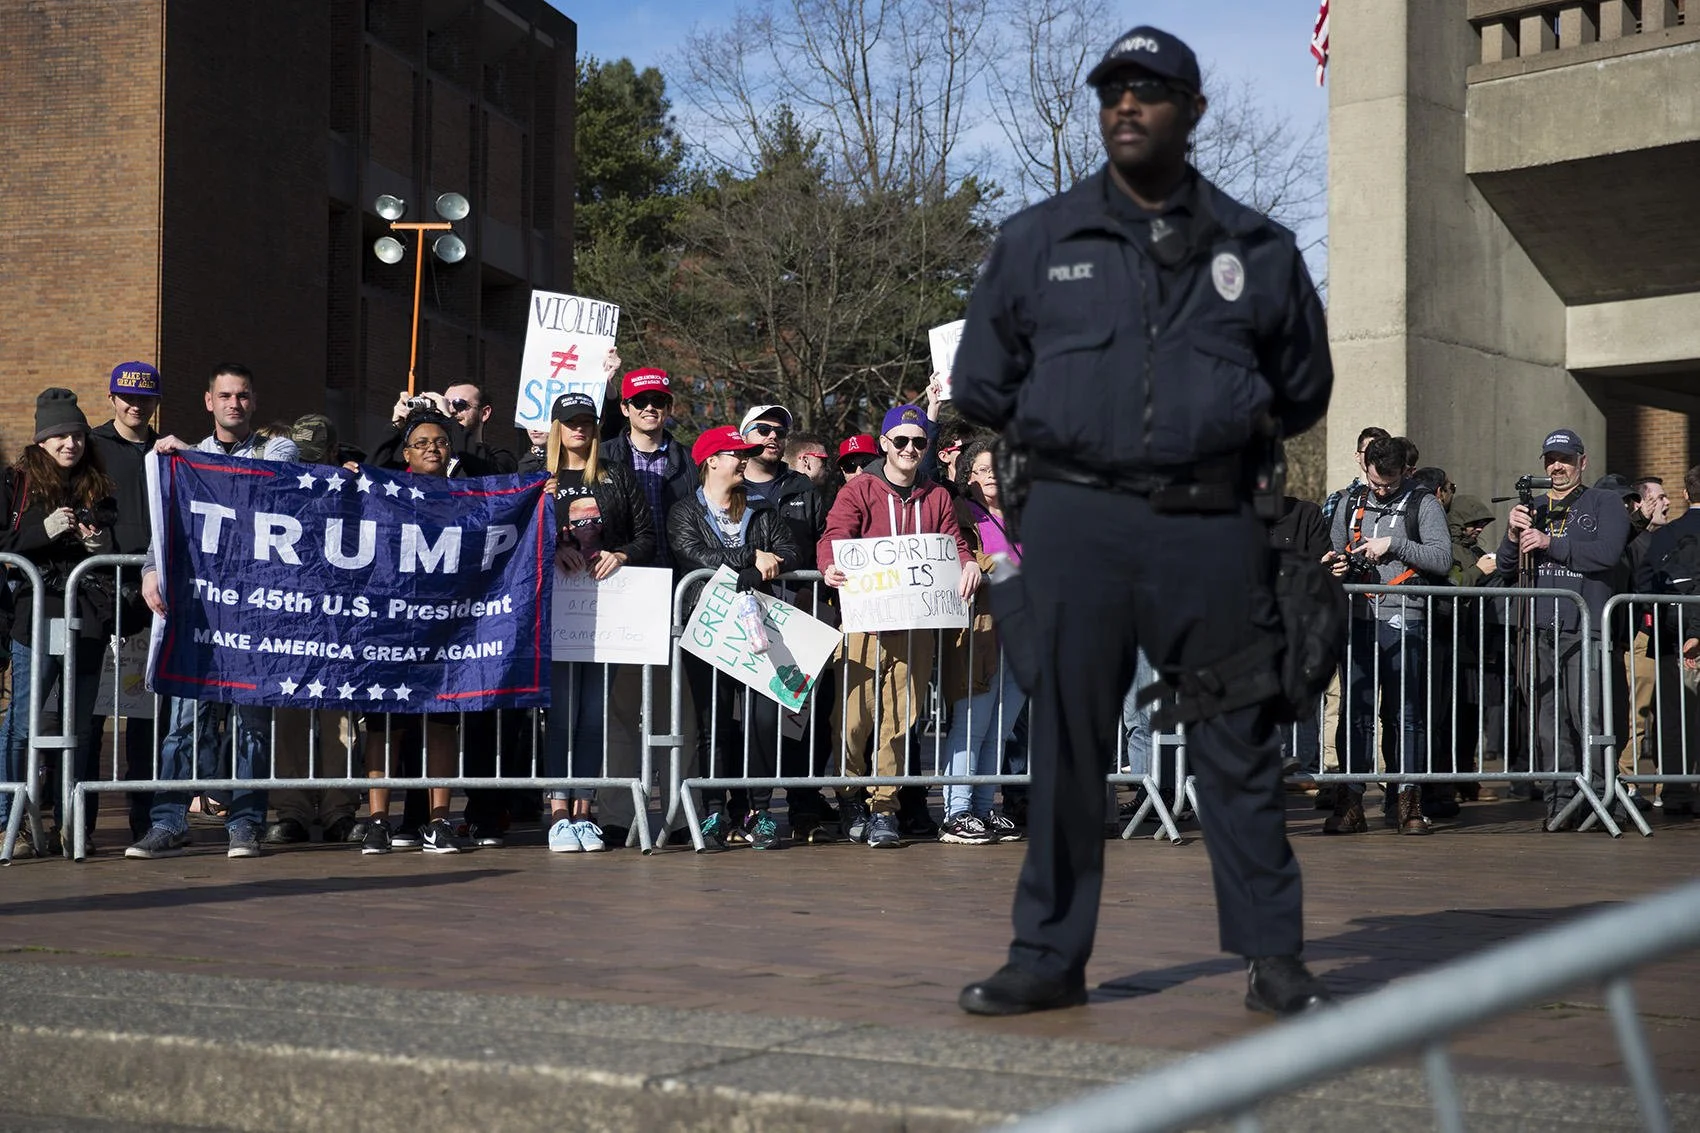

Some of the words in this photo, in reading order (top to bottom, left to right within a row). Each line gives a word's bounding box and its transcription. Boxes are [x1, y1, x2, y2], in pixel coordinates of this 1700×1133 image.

[1048, 263, 1094, 281] POLICE
[534, 296, 620, 338] VIOLENCE
[848, 436, 860, 451] A
[190, 500, 518, 574] TRUMP
[873, 537, 956, 565] GARLIC
[843, 568, 902, 594] COIN
[907, 563, 934, 587] IS
[189, 578, 239, 605] The
[248, 587, 312, 613] 45th
[322, 594, 378, 618] U.S.
[388, 594, 512, 620] President
[568, 599, 598, 610] are
[692, 572, 739, 648] GREEN
[194, 628, 251, 650] MAKE
[258, 637, 354, 660] AMERICA
[362, 645, 430, 661] GREAT
[434, 640, 503, 661] AGAIN!
[551, 628, 613, 641] reamers
